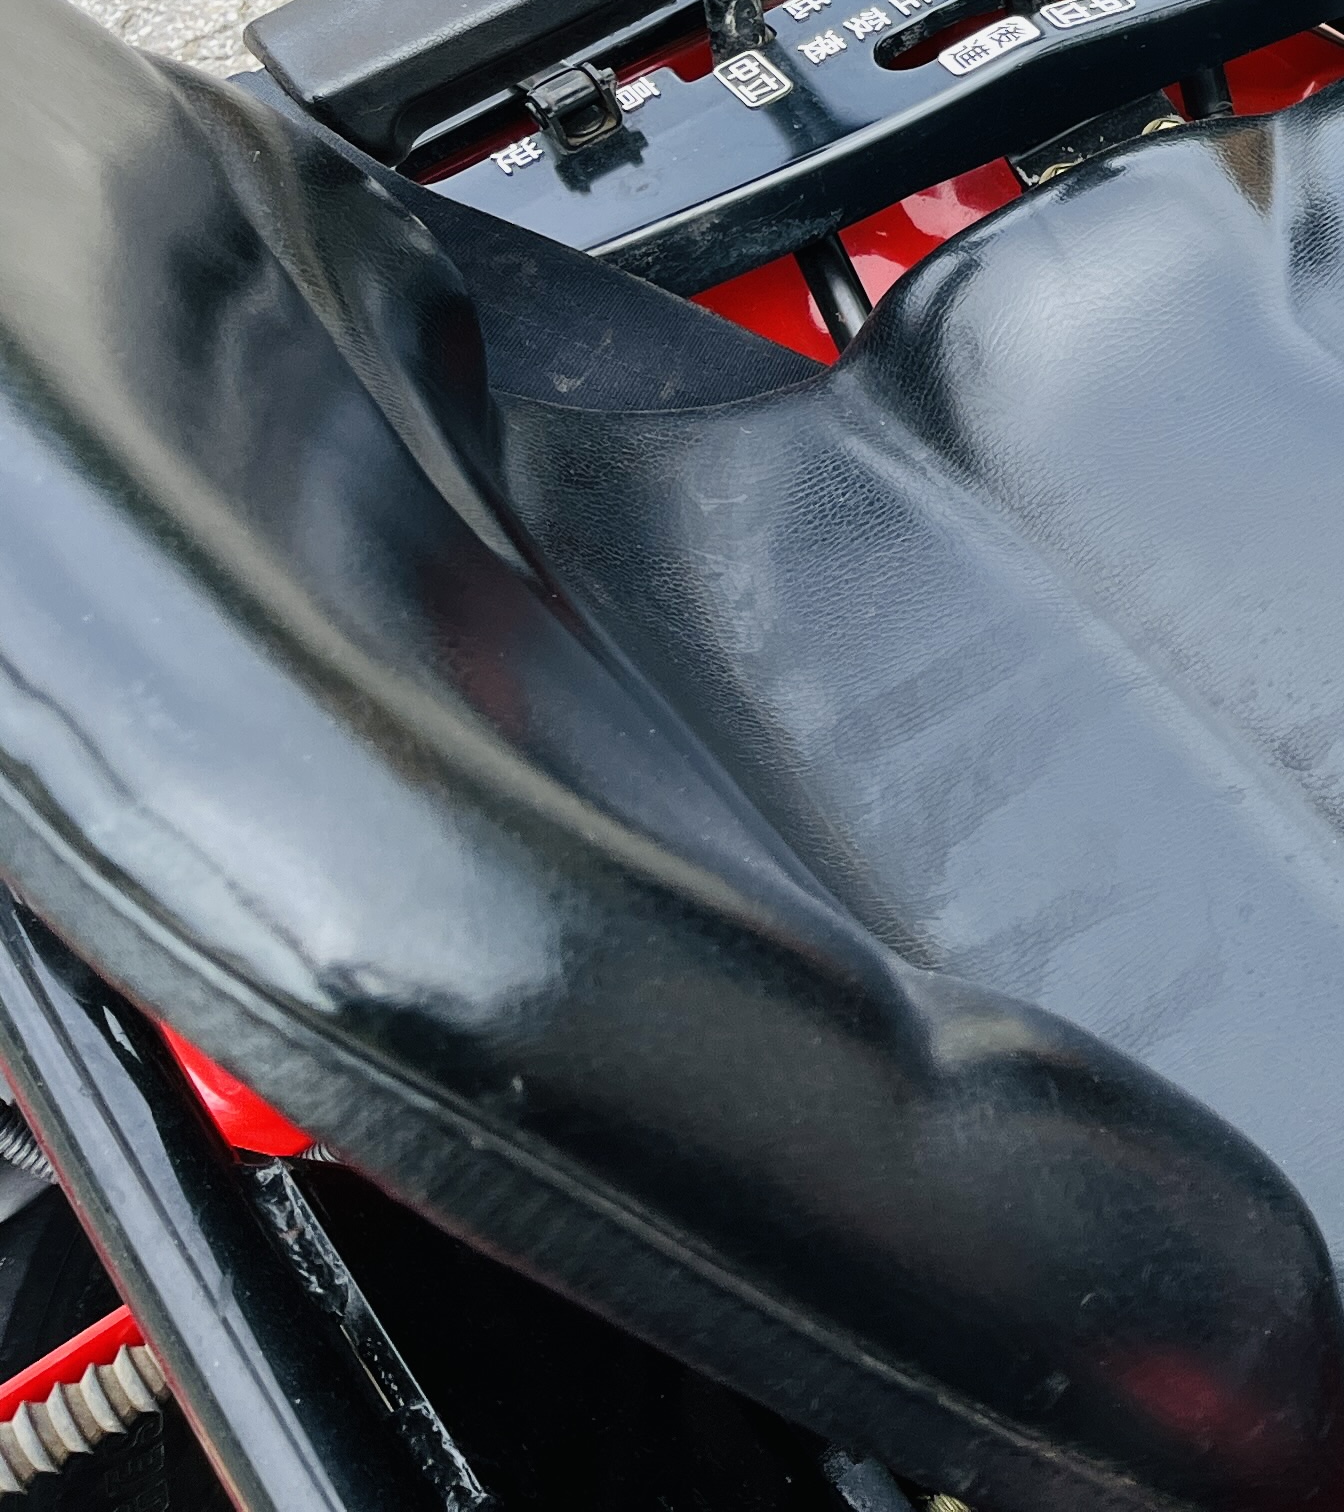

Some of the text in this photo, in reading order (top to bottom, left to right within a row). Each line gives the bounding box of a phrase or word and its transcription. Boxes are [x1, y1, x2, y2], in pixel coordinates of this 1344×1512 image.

[948, 19, 1032, 71] 後進
[615, 76, 661, 113] 高
[722, 57, 788, 102] 中立
[490, 137, 544, 175] 逆
